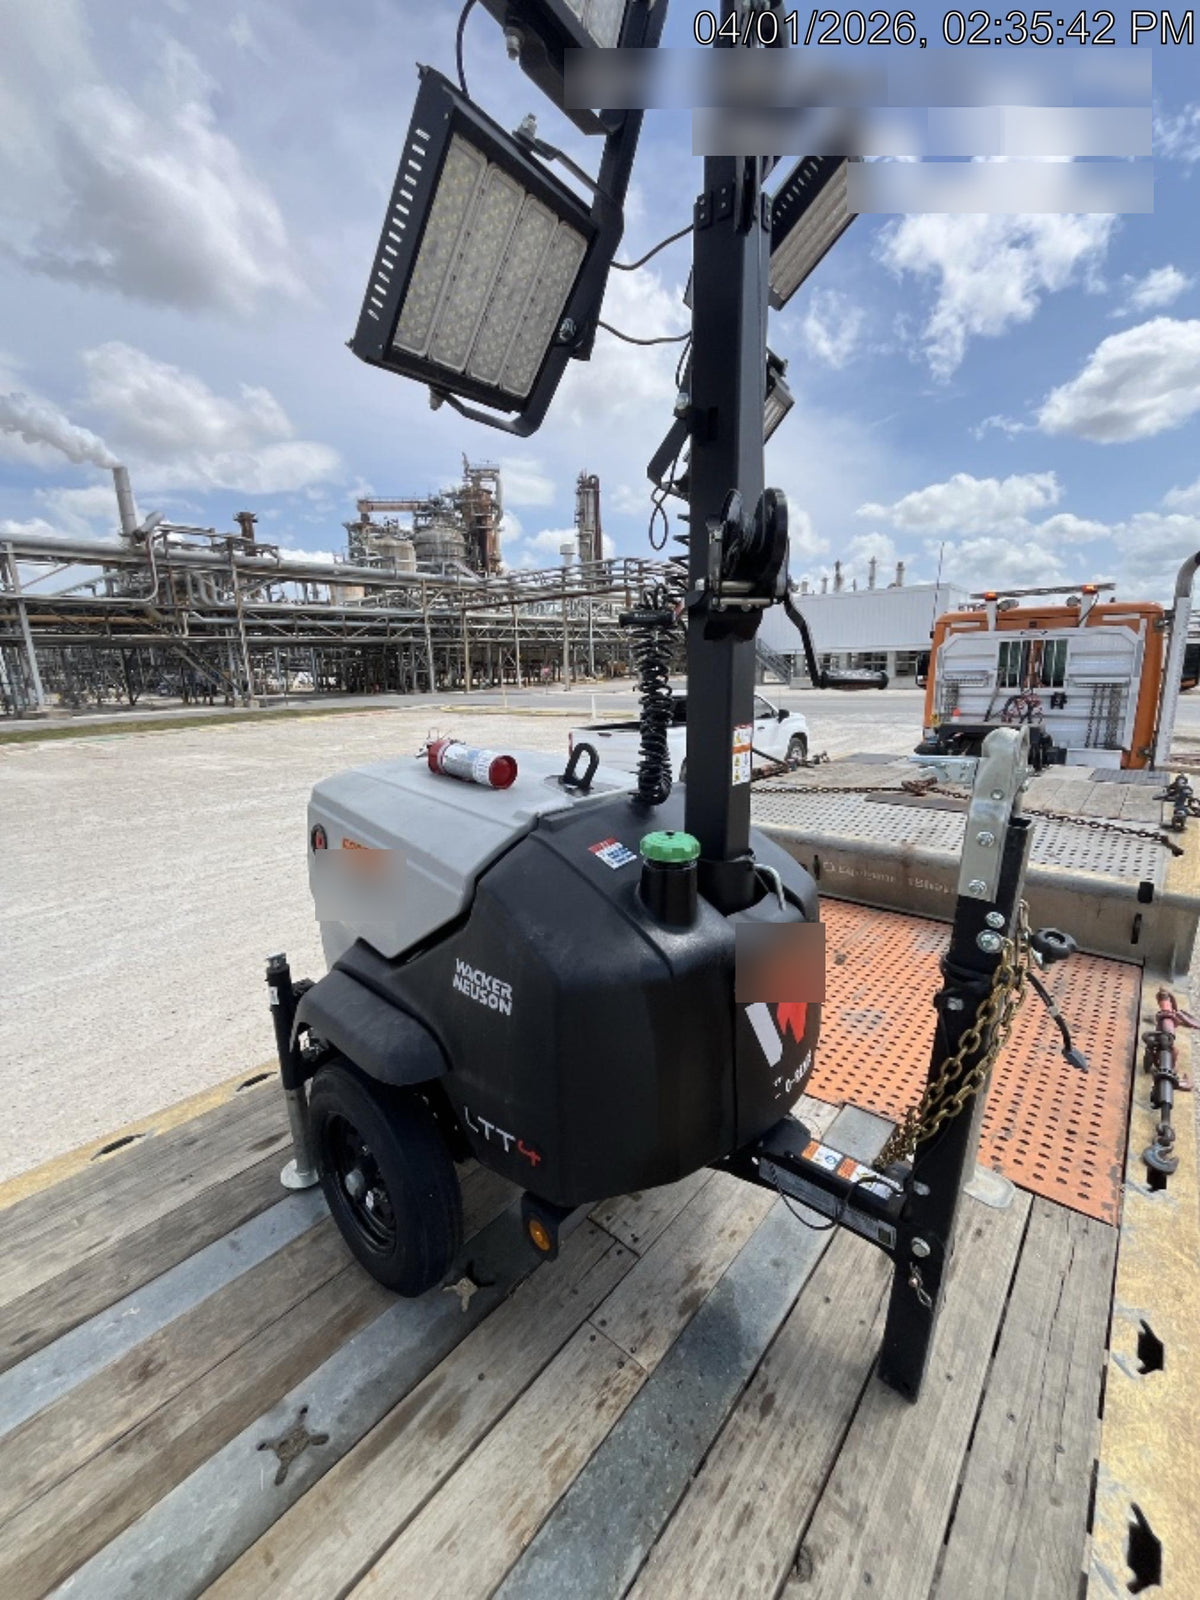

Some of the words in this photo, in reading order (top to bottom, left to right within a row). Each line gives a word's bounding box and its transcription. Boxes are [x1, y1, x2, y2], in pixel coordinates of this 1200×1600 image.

[453, 974, 512, 1015] NEUSON
[456, 958, 512, 1001] WACKER
[464, 1106, 541, 1167] LTT4
